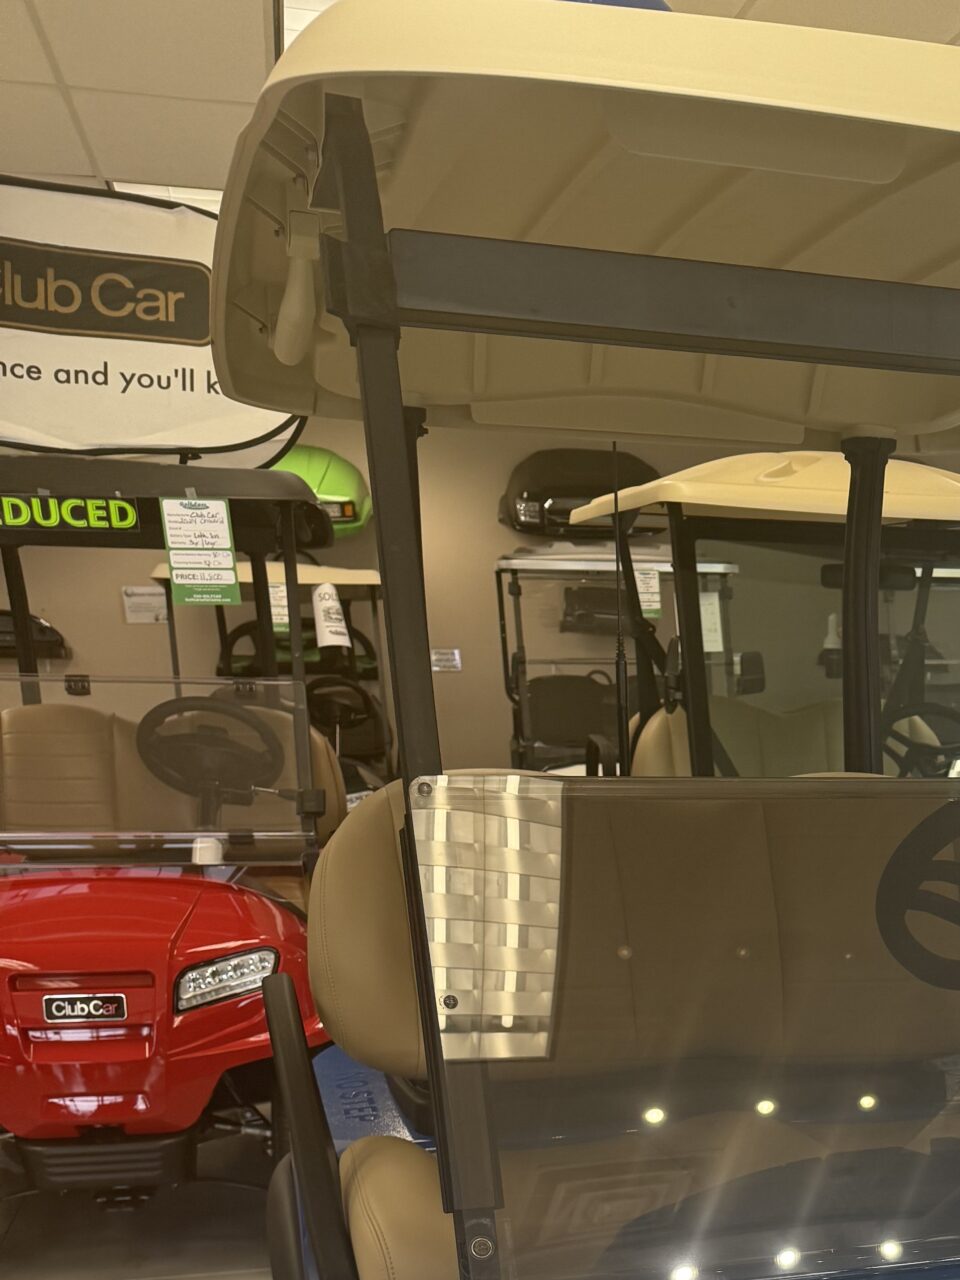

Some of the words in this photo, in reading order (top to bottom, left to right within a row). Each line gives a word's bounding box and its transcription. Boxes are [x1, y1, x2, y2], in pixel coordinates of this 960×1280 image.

[0, 260, 83, 314] lub
[90, 272, 186, 323] Car
[53, 361, 109, 386] and
[119, 367, 195, 394] you'll
[0, 497, 137, 529] DUCED
[51, 1001, 89, 1017] Club
[89, 1000, 118, 1015] Car
[340, 1090, 378, 1122] STEP
